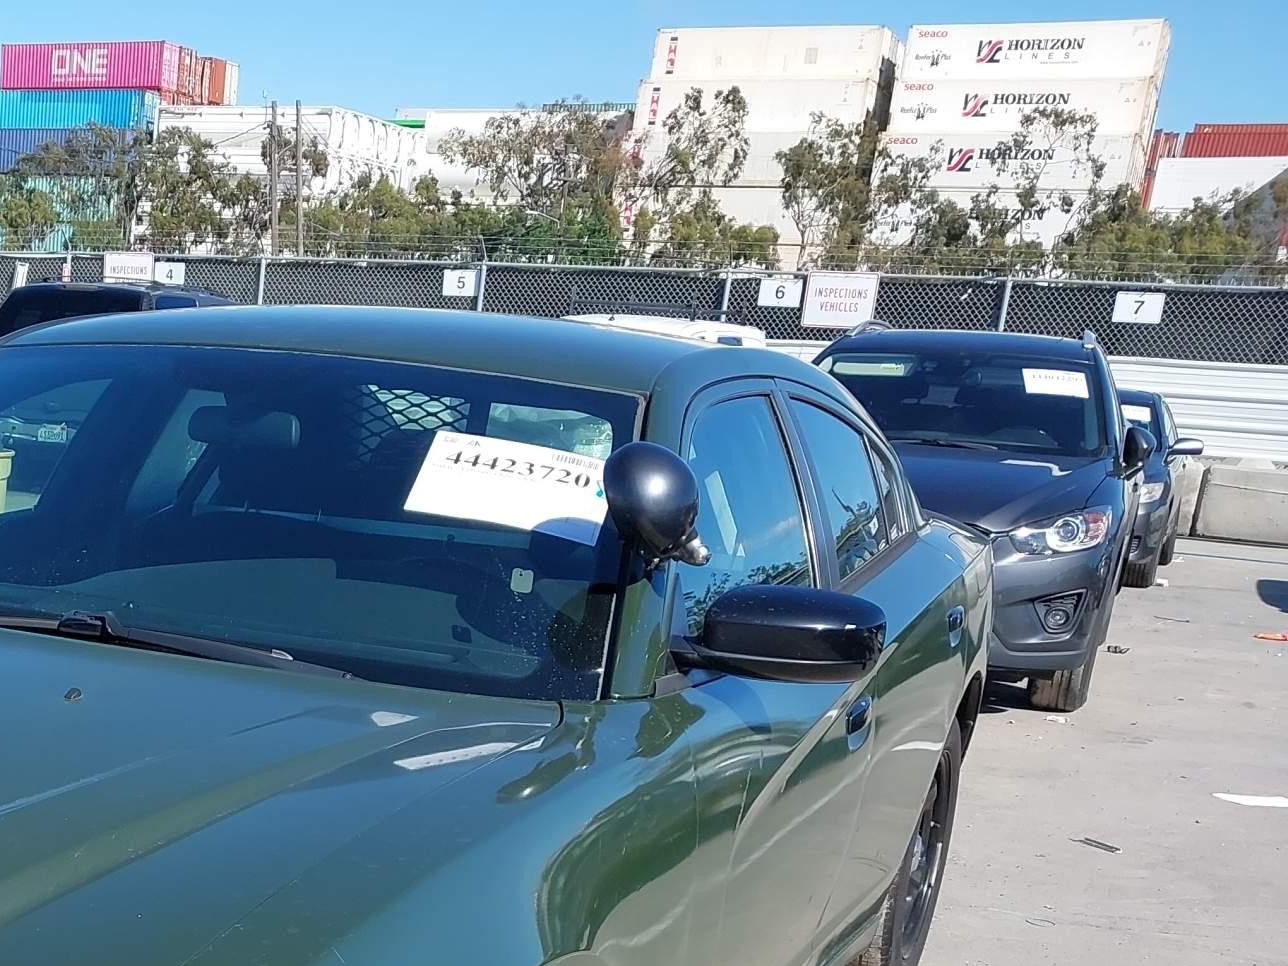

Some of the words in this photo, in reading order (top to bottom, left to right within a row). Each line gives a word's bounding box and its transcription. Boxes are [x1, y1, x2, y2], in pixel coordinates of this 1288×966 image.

[918, 30, 949, 39] seaco
[1007, 37, 1086, 51] HORIZON
[53, 48, 108, 75] ONE
[1004, 52, 1071, 60] LINES
[903, 82, 934, 91] seaco
[992, 93, 1071, 105] HORIZON
[887, 136, 918, 145] seaco
[977, 148, 1055, 160] HORIZON
[110, 265, 148, 275] INSPECTIONS
[165, 269, 173, 281] 4
[457, 276, 466, 289] 5
[775, 285, 786, 299] 6
[814, 287, 869, 299] INSPECTIONS
[819, 301, 859, 313] VEHICLES
[1134, 300, 1145, 315] 7
[445, 450, 591, 489] 44423720
